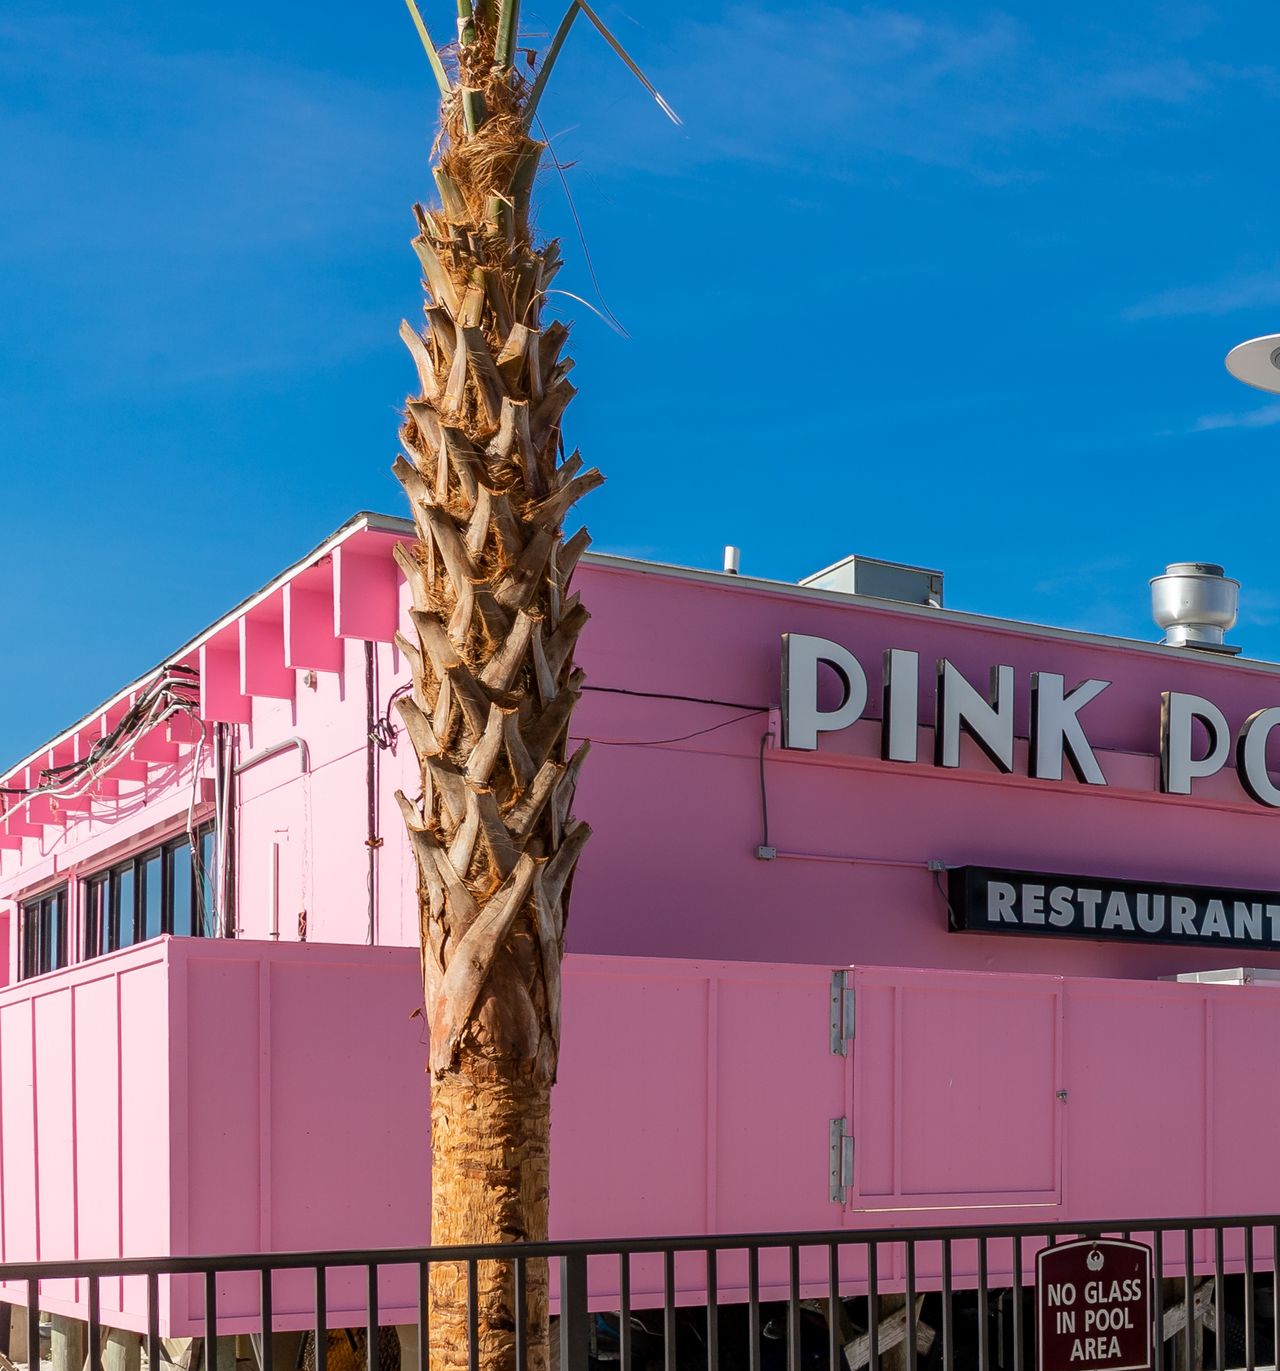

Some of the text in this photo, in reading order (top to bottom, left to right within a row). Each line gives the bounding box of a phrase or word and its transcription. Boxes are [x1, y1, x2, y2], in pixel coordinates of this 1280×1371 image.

[781, 632, 1112, 786] PINK
[1047, 1279, 1142, 1307] NO GLASS
[1056, 1307, 1134, 1334] IN POOL
[1070, 1336, 1122, 1362] AREA
